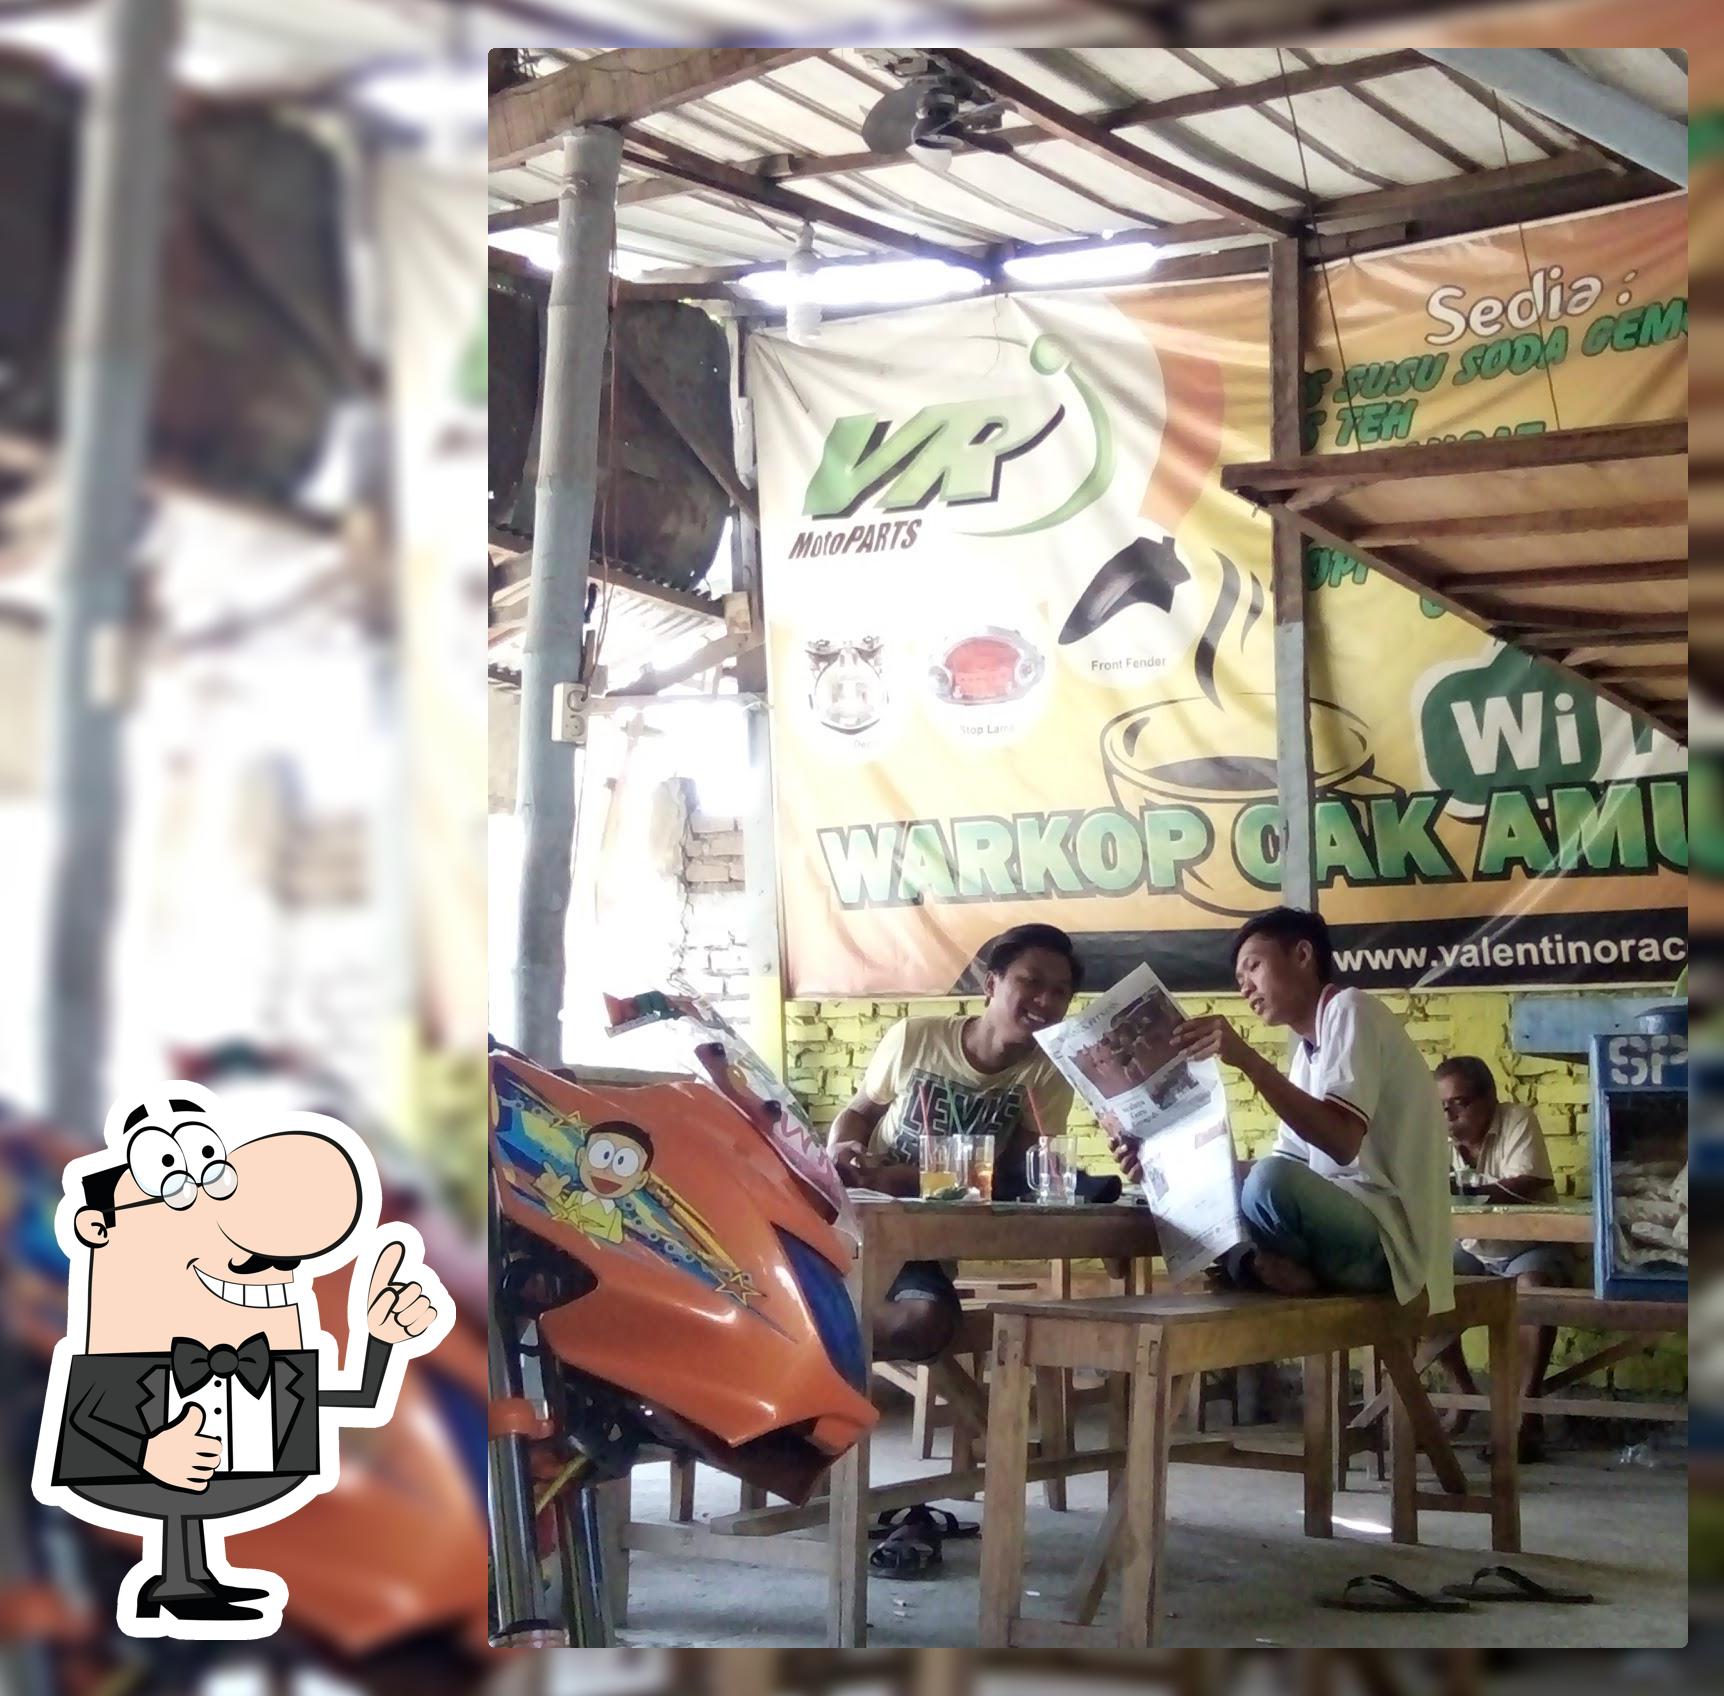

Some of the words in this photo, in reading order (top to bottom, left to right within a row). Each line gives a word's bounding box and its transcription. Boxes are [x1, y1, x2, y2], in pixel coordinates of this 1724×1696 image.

[1426, 266, 1604, 345] Sedia
[1333, 352, 1449, 403] SUSU
[1453, 326, 1569, 386] SODA
[1581, 297, 1687, 357] GEM
[1335, 398, 1419, 446] TEH
[788, 518, 922, 560] MotoPARTS
[1091, 659, 1122, 672] Front
[1125, 656, 1166, 670] Fender
[818, 804, 1212, 908] WARKOP
